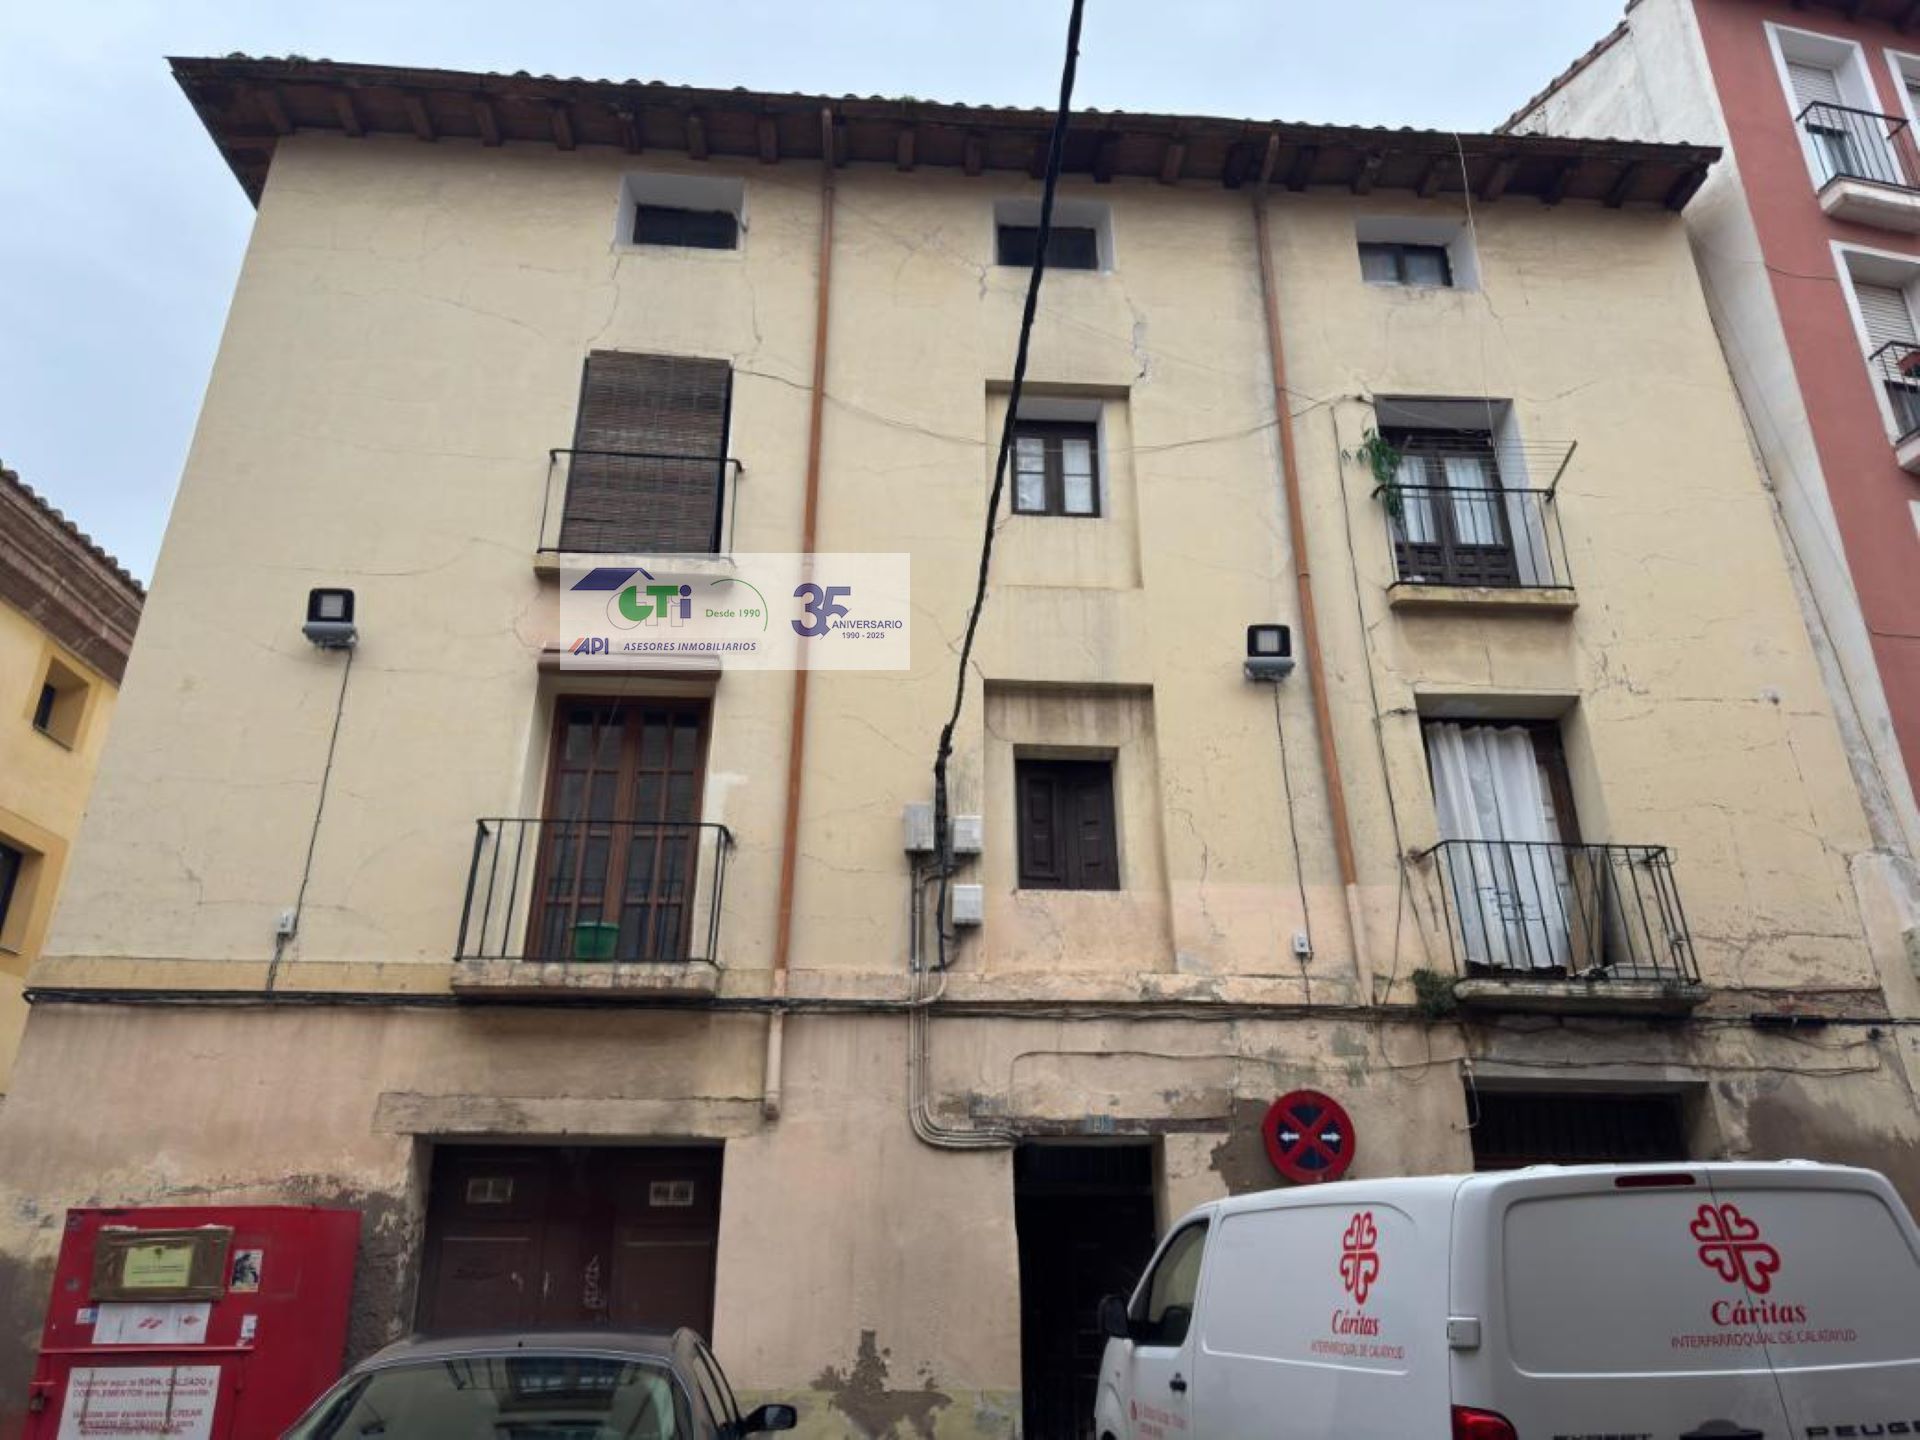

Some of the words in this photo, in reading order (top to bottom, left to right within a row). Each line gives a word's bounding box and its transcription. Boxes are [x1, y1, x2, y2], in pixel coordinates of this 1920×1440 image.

[1332, 1309, 1379, 1336] Cáritas
[1711, 1299, 1807, 1326] Cáritas
[1778, 1331, 1796, 1344] DE
